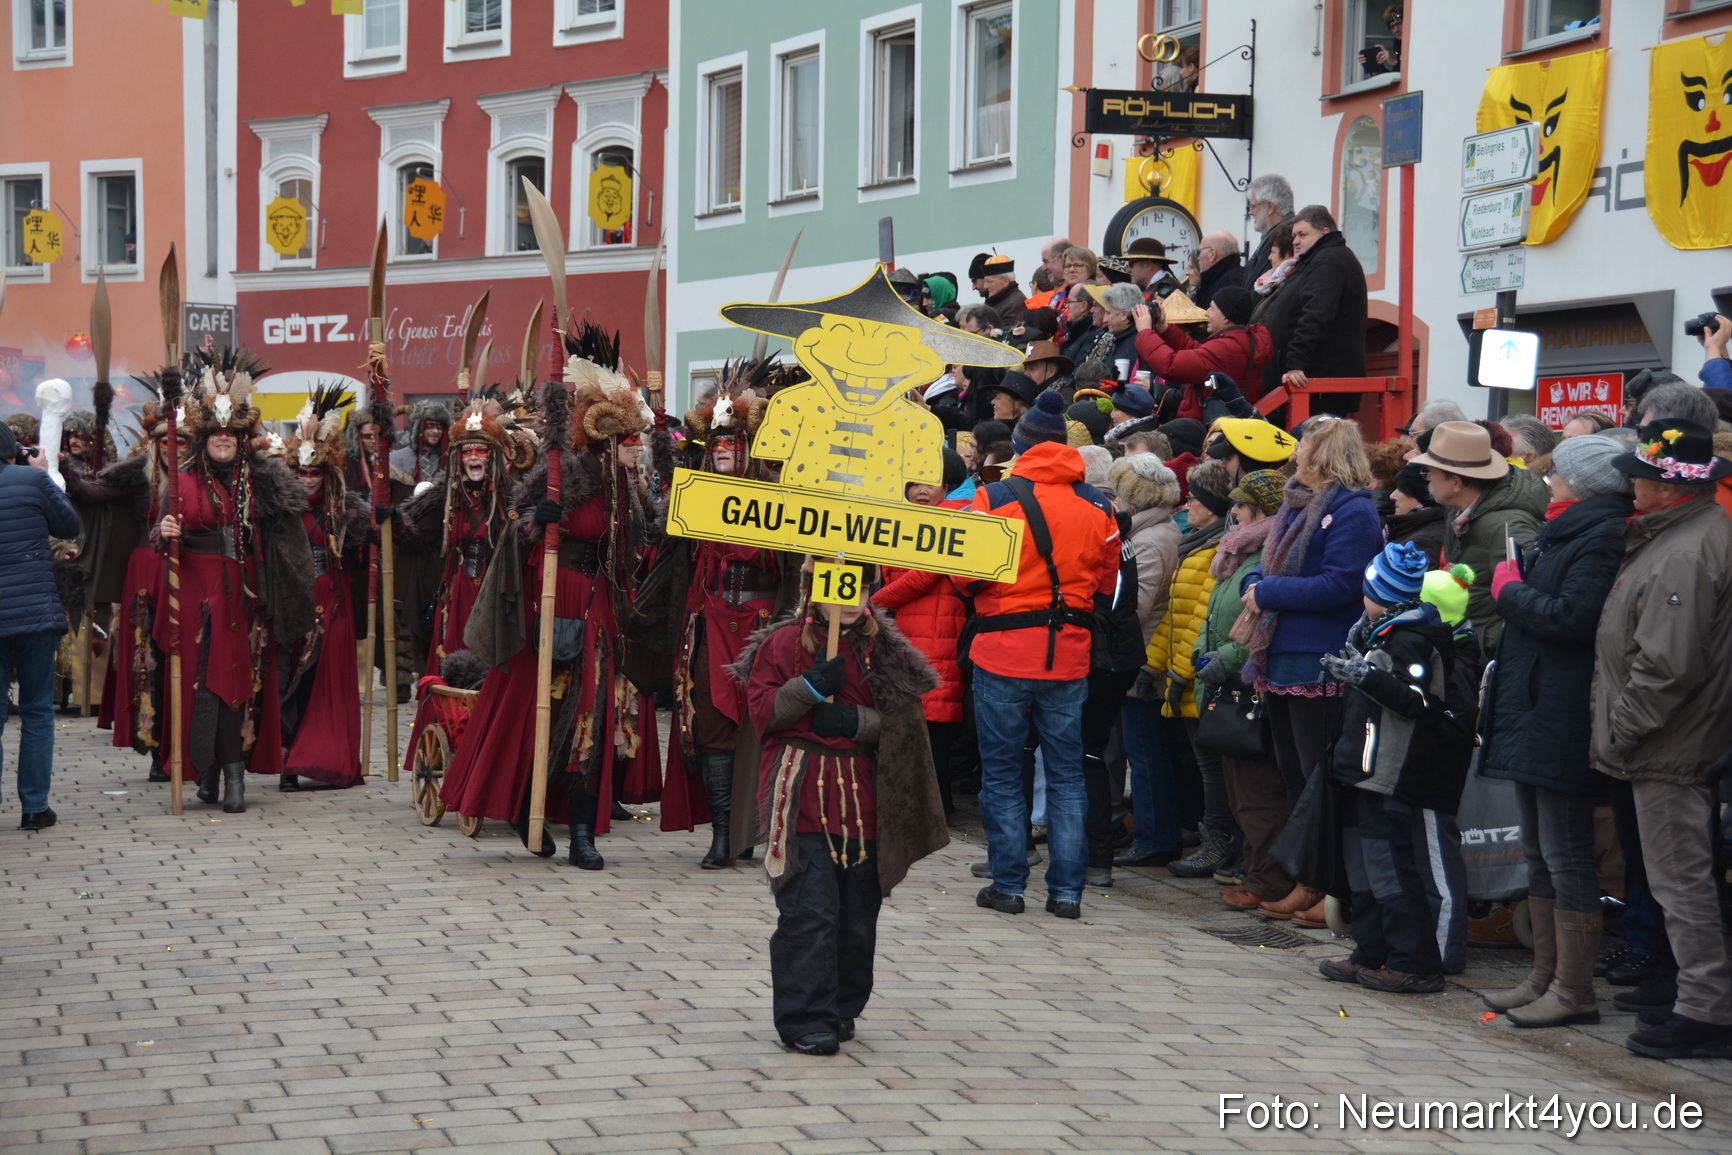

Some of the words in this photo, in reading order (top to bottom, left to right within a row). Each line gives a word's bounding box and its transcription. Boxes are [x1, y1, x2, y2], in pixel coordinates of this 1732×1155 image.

[1102, 96, 1235, 120] RÖHLICH
[1476, 141, 1505, 157] Beilngries
[1475, 168, 1495, 182] Töging
[1153, 210, 1164, 223] 12
[1472, 201, 1502, 216] Riedenburg
[1129, 226, 1139, 238] 10
[1470, 226, 1495, 241] Mühlbach
[1472, 258, 1494, 272] Parsberg
[188, 309, 230, 332] CAFÉ
[358, 306, 398, 343] Mde
[399, 316, 438, 351] Genuss
[442, 303, 493, 339] Erlis
[1537, 320, 1654, 351] RAURINGE
[1566, 381, 1592, 402] WIR
[721, 494, 967, 558] GAU-DI-WEI-DIE
[818, 569, 858, 601] 18
